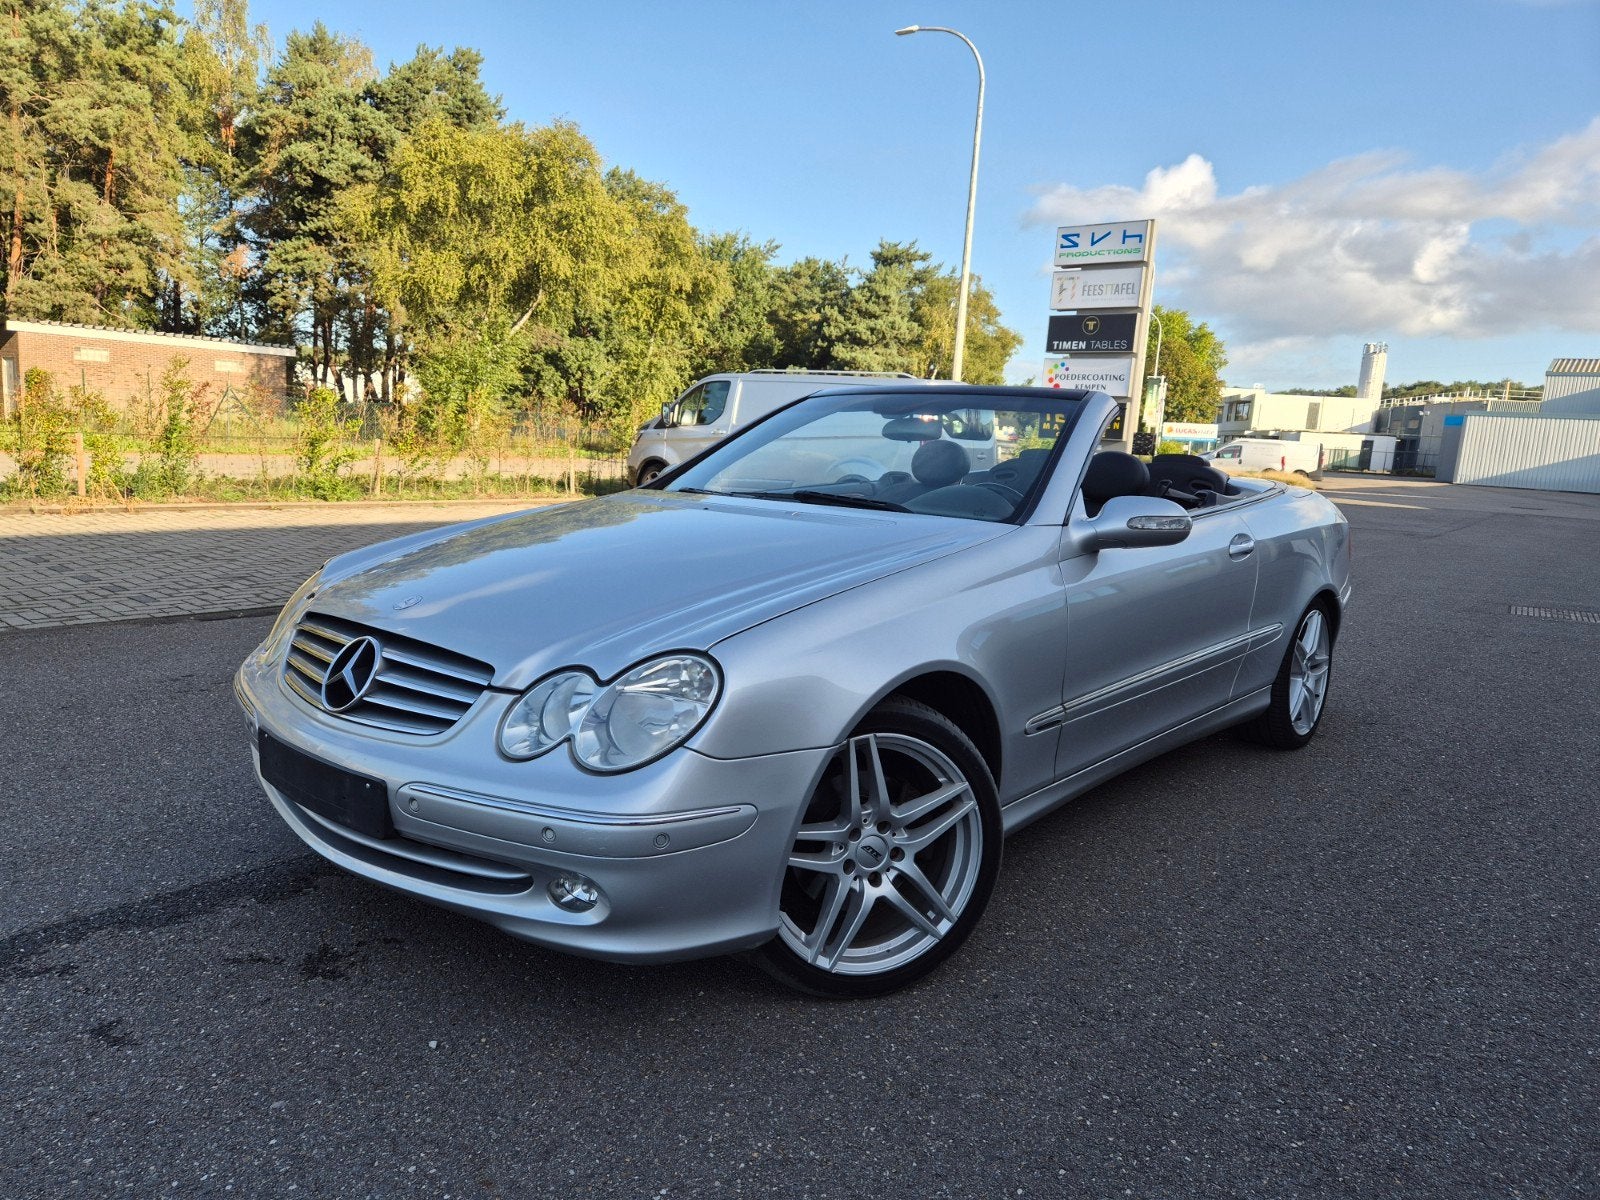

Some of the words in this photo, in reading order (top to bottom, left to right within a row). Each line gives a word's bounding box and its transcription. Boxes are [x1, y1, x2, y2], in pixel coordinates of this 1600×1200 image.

[1059, 247, 1142, 258] PRODUCTIONS
[1081, 282, 1136, 297] FEESTTAFEL
[1052, 341, 1087, 350] TIMEN
[1089, 340, 1128, 350] TABLES
[1054, 373, 1126, 382] POEDERCOATING
[1074, 383, 1107, 391] KEMPEN
